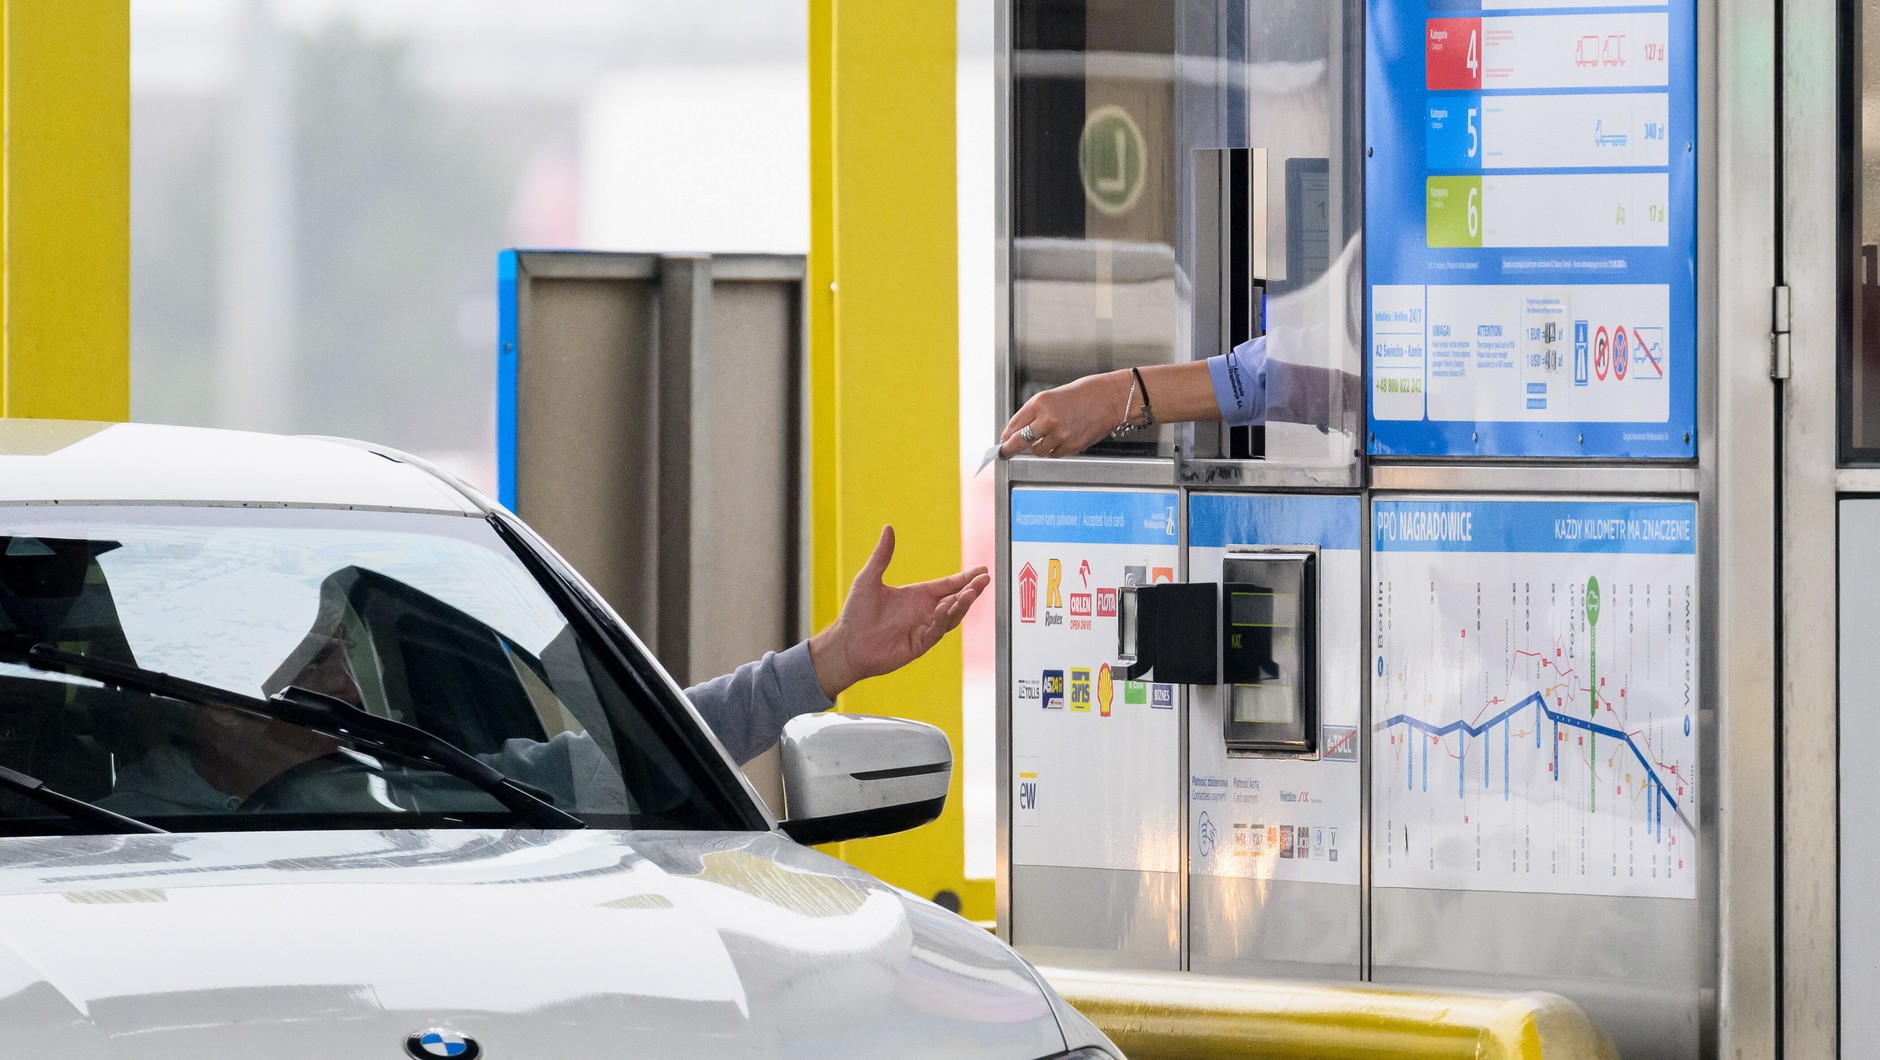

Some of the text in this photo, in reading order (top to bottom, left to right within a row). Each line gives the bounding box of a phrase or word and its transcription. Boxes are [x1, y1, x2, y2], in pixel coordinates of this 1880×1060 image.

[1466, 30, 1478, 78] 4
[1644, 44, 1656, 60] 127
[1467, 109, 1478, 158] 5
[1644, 122, 1656, 140] 340
[1468, 187, 1478, 237] 6
[1649, 205, 1656, 222] 17
[1409, 308, 1421, 323] 24/7
[1531, 328, 1540, 340] EUR
[1376, 344, 1383, 357] A2
[1376, 378, 1387, 392] +48
[1378, 512, 1472, 541] PPO NAGRADOWICE
[1555, 514, 1690, 540] KAŻDY KILOMETR MA ZNACZENIE
[1071, 597, 1091, 613] ORLEN
[1045, 611, 1063, 626] Routex
[1070, 620, 1091, 630] OPEN DRIVE
[1072, 675, 1090, 703] aris
[1020, 783, 1036, 809] ew
